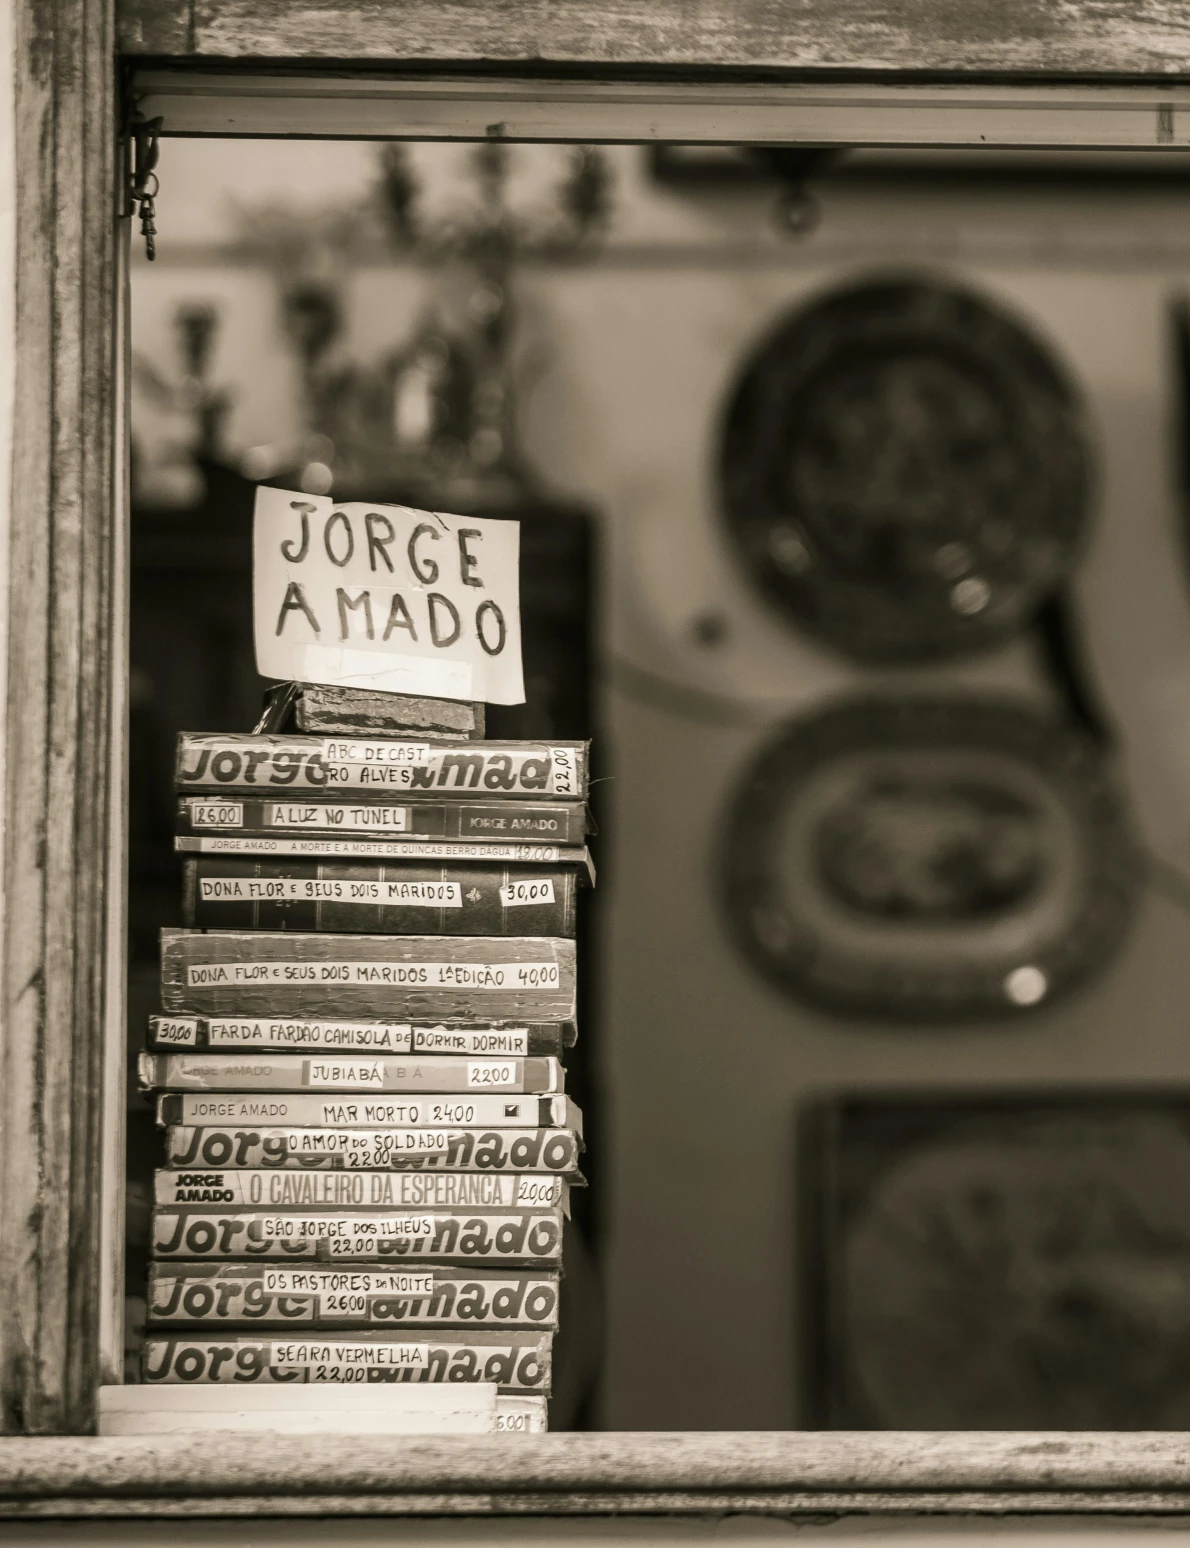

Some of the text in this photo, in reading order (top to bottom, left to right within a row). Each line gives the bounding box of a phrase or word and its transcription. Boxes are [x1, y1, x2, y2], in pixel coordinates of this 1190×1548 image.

[279, 500, 485, 588] JORGE
[275, 581, 507, 656] AMADO
[328, 743, 425, 761] ABC DE CAST
[329, 766, 410, 784] RO ALVES
[555, 749, 574, 793] 22,00
[275, 811, 285, 823] A
[289, 808, 318, 822] LUZ
[326, 809, 344, 825] NO
[470, 817, 558, 831] JORGE AMADO
[211, 840, 241, 850] JORGE
[244, 841, 278, 851] AMADO
[291, 843, 298, 851] A
[300, 843, 331, 852] MORTE
[335, 844, 340, 852] E
[343, 844, 350, 852] A
[352, 844, 382, 853] MORTE
[387, 845, 399, 853] DE
[402, 845, 443, 855] QUINCAS
[446, 846, 477, 855] BERRO
[202, 881, 243, 897] DONA
[249, 882, 285, 897] FLOR
[305, 881, 343, 897] SEUS
[351, 884, 379, 898] DOIS
[507, 884, 549, 902] 30,00
[191, 969, 229, 984] DONA
[235, 966, 269, 980] FLOR
[285, 967, 316, 980] SEUS
[321, 966, 350, 980] DOIS
[357, 967, 428, 983] MARIDOS
[518, 967, 558, 987] 40,00
[159, 1022, 193, 1042] 30,00
[211, 1022, 524, 1052] FARDA FARDÃO CAMISOLA DE DORMIR DORMIR
[312, 1061, 384, 1083] JUBIABÁ
[191, 1103, 288, 1116] JORGE AMADO
[323, 1105, 419, 1123] MAR MORTO
[288, 1133, 445, 1151] O AMOR DO SOLDADO
[175, 1174, 224, 1187] JORGE
[249, 1173, 263, 1204] O
[269, 1174, 364, 1204] CAVALEIRO
[371, 1174, 394, 1204] DA
[175, 1190, 234, 1203] AMADO
[518, 1181, 554, 1205] 20,00
[265, 1216, 432, 1237] SÃO JORGE DOS ILHÉUS
[332, 1238, 374, 1255] 22,00
[267, 1273, 287, 1290] OS
[292, 1274, 370, 1292] PASTORES
[390, 1276, 433, 1292] NOITE
[277, 1345, 422, 1364] SEARA VERMELHA
[315, 1366, 365, 1383] 22,00
